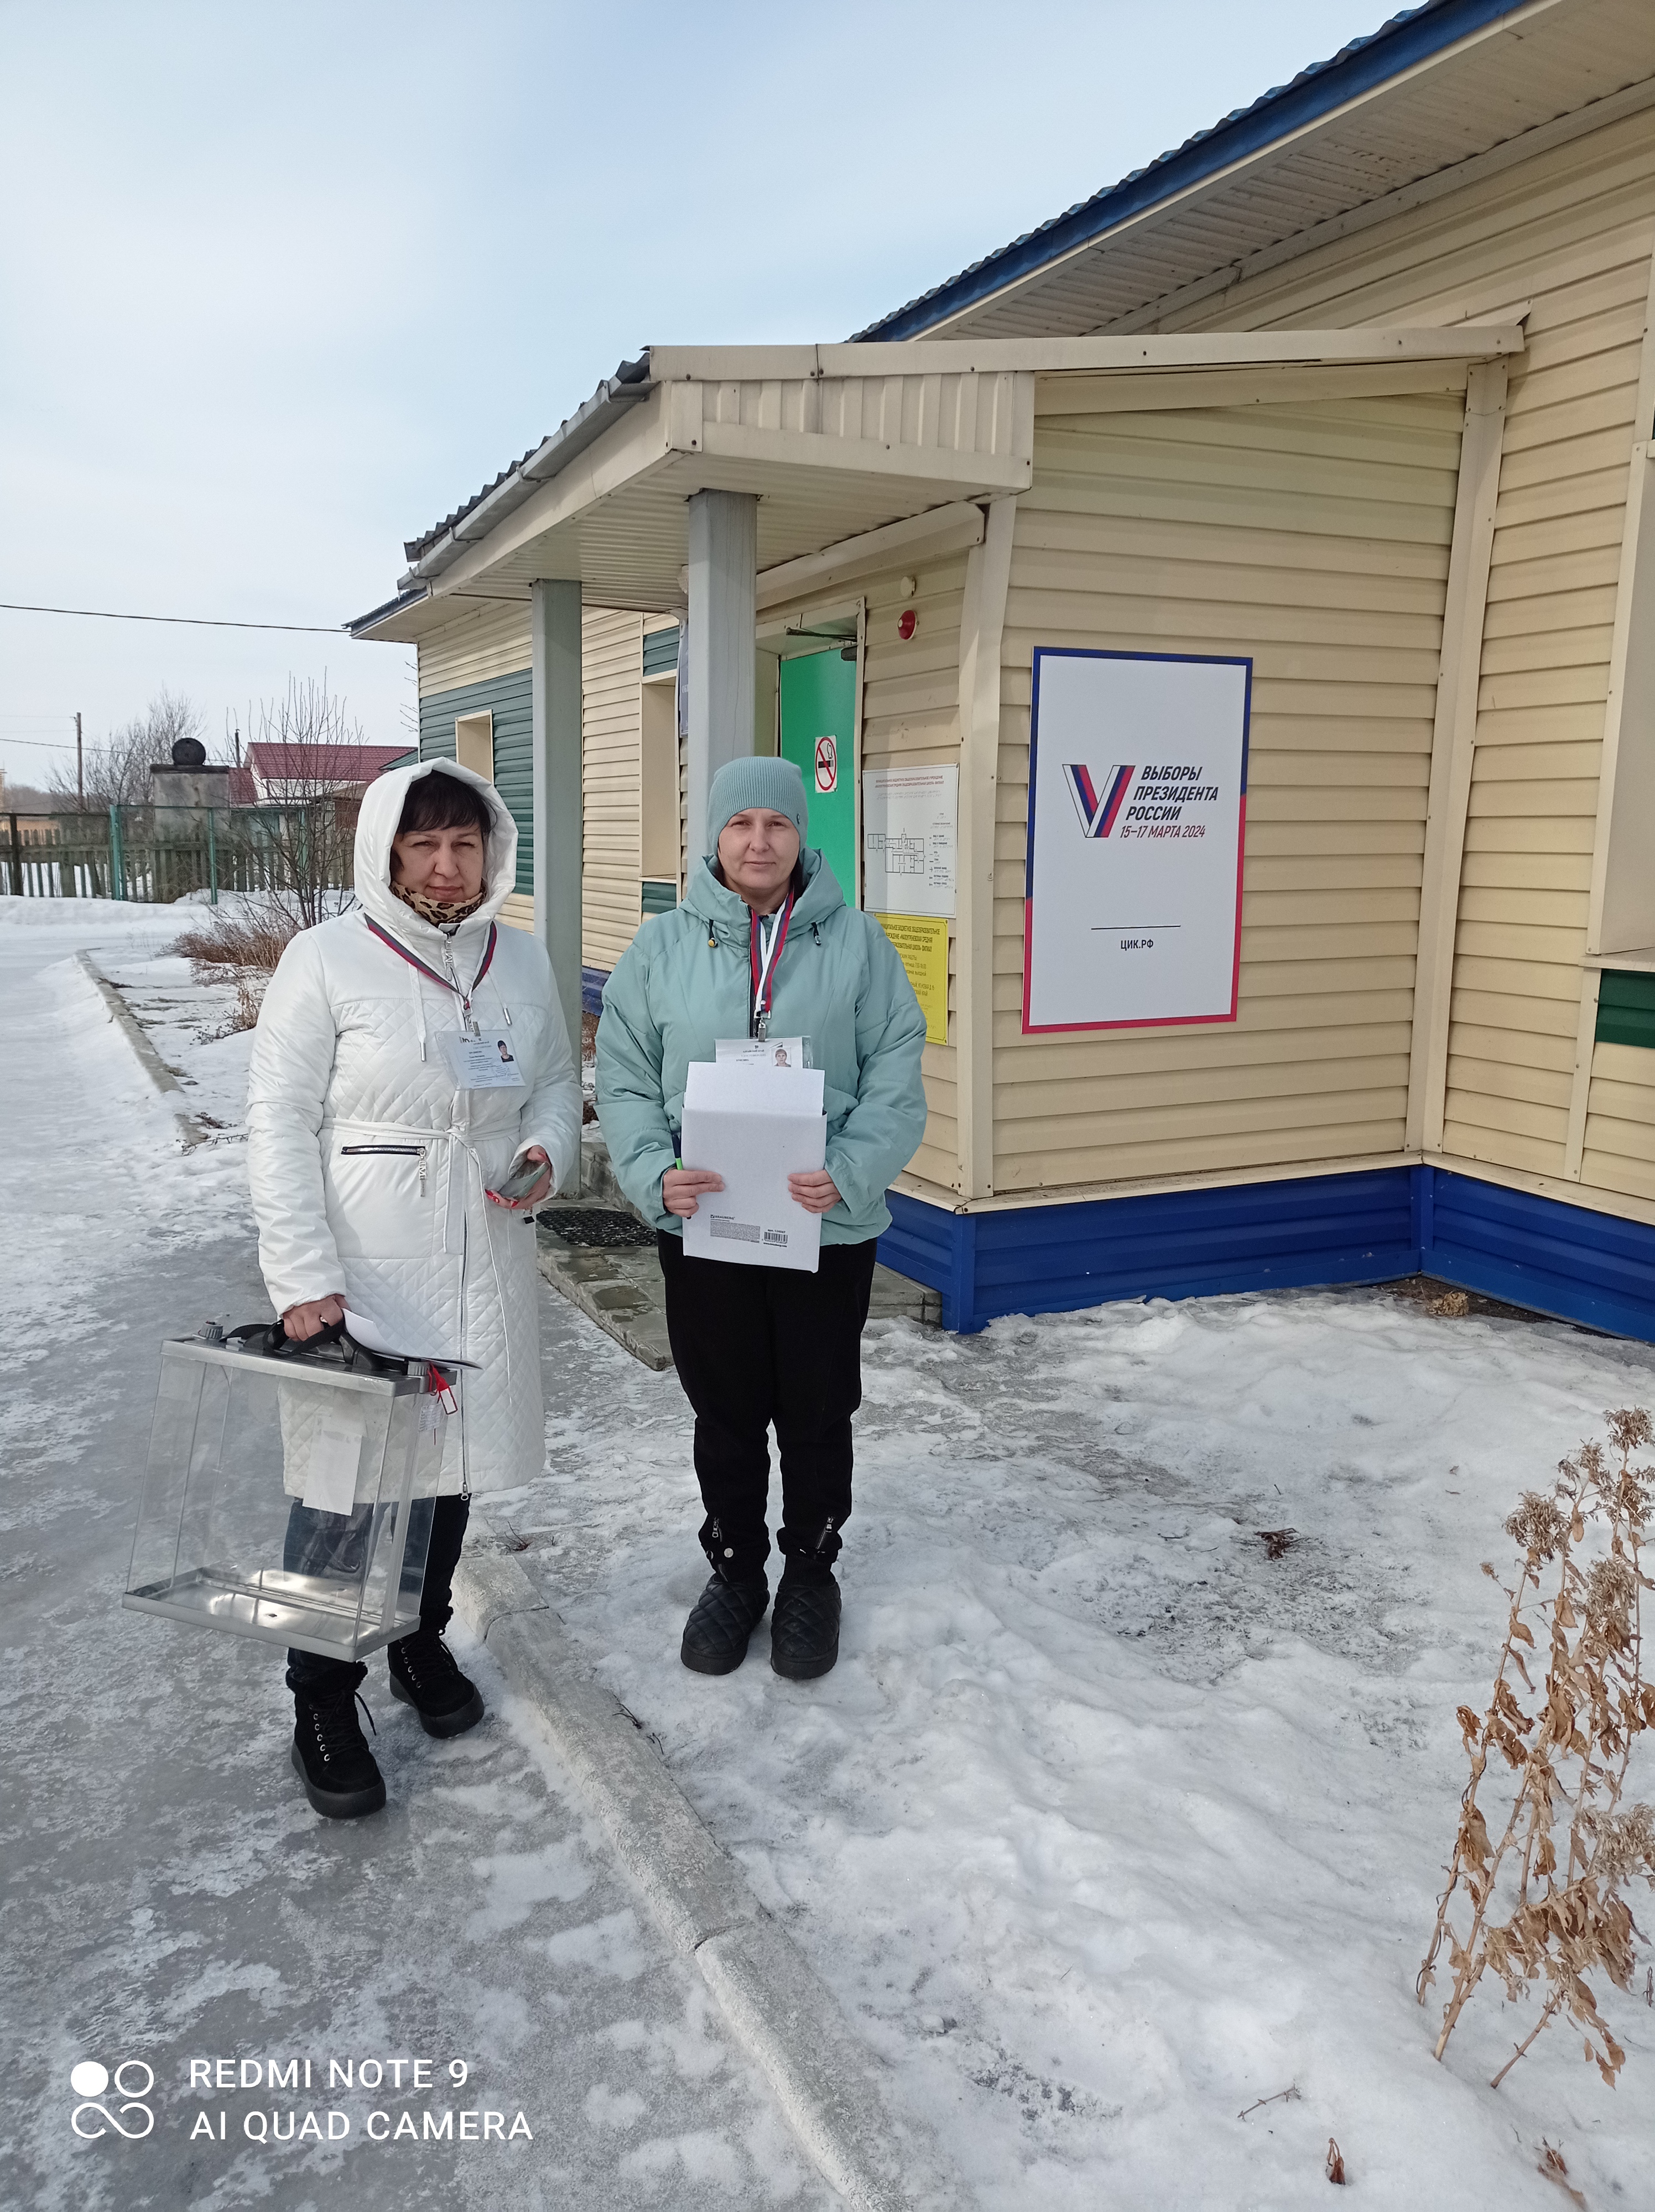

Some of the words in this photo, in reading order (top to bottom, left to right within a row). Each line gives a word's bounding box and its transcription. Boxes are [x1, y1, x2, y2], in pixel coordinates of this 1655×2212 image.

[1141, 766, 1203, 781] ВЫБОРЫ
[1133, 786, 1219, 802] ПРЕЗИДЕНТА
[1126, 806, 1182, 821] РОССИИ
[1148, 826, 1182, 838] МАРТА
[1182, 825, 1206, 838] 2024
[1121, 939, 1153, 951] ЦИК.РФ
